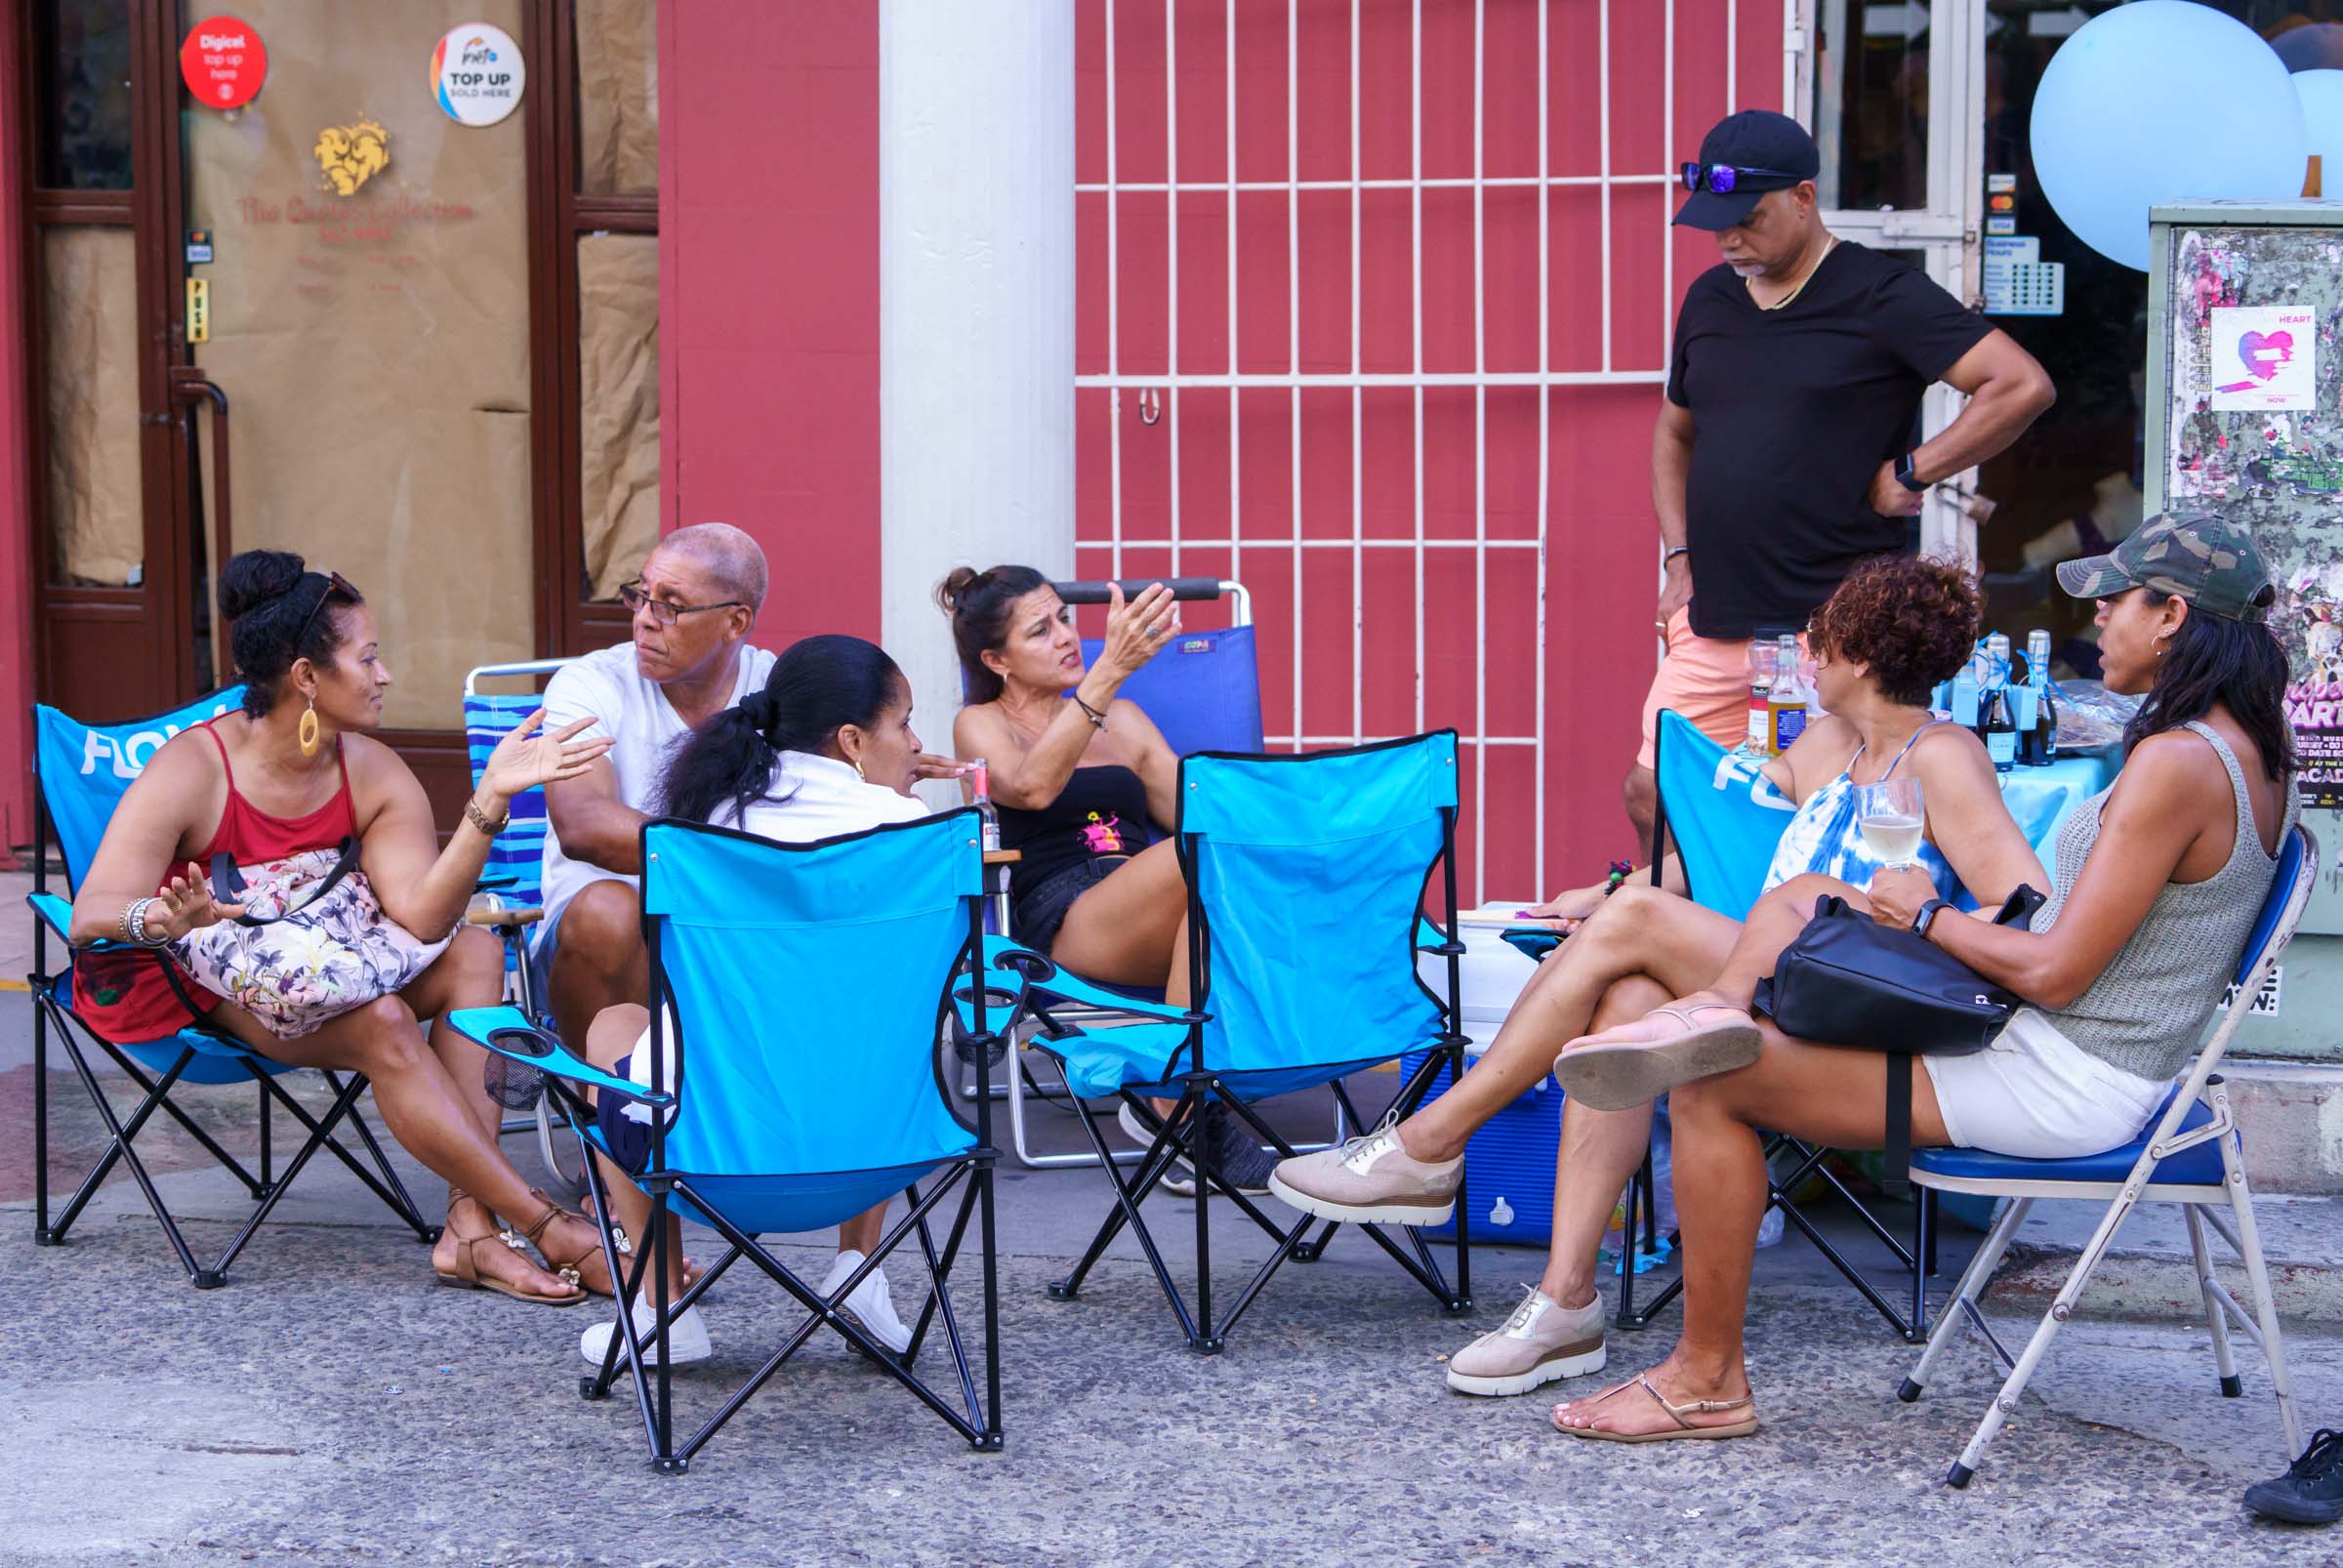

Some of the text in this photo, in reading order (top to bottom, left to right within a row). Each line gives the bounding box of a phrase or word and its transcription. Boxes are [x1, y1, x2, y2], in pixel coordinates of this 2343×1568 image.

[199, 34, 246, 52] Digicel
[203, 54, 244, 67] top up
[210, 68, 238, 80] here
[450, 73, 512, 86] TOP UP
[451, 89, 511, 98] SOLD HERE
[237, 196, 280, 223] The
[2280, 315, 2312, 324] HEART
